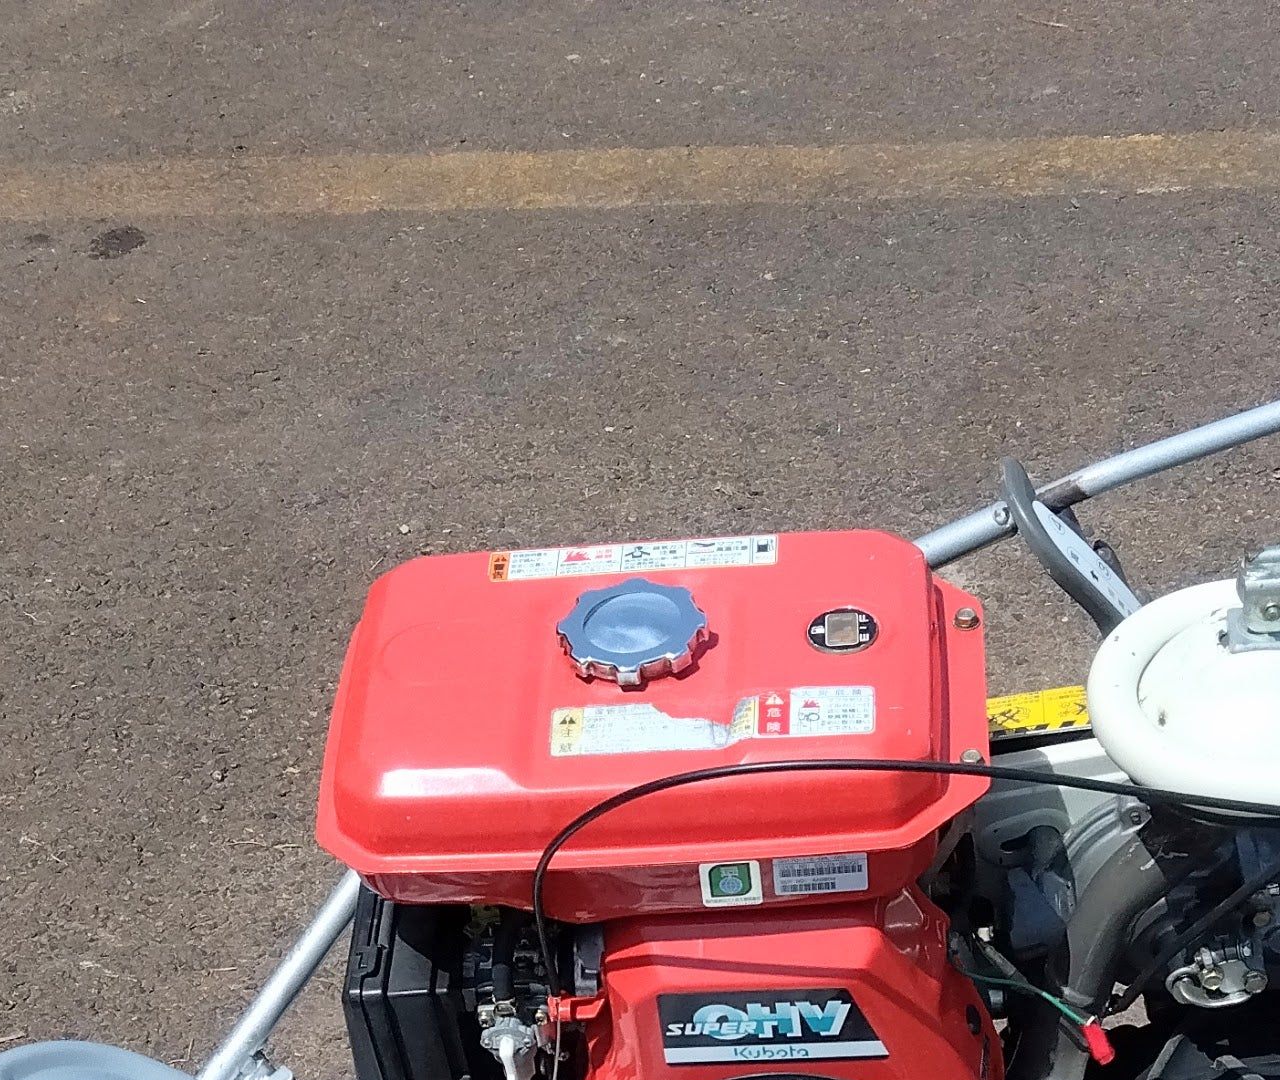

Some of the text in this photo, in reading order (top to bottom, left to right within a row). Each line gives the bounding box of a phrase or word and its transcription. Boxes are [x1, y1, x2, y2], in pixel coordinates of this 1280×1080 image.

[766, 707, 782, 732] 危険
[666, 1000, 851, 1040] SUPER OHV
[734, 1046, 809, 1059] Kubota
